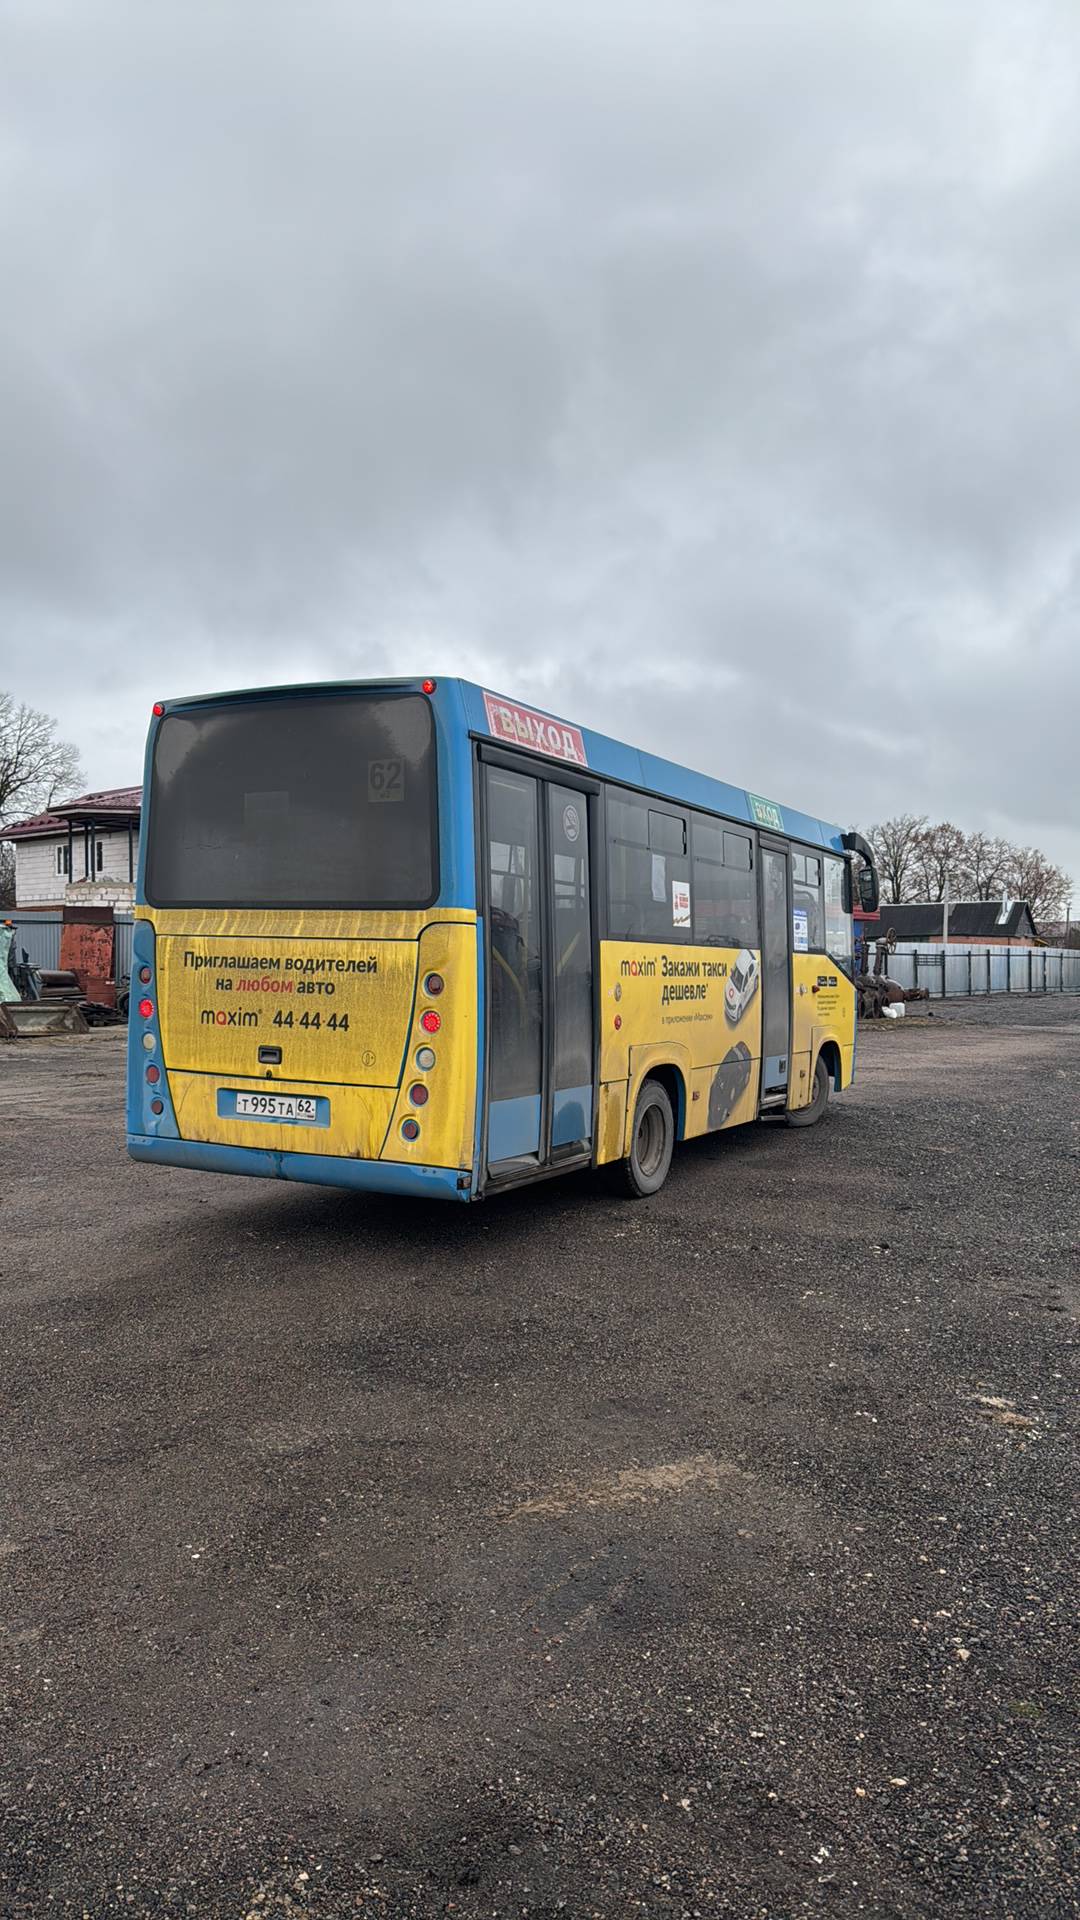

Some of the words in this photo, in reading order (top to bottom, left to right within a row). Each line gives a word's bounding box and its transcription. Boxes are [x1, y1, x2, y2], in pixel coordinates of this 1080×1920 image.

[496, 705, 578, 760] ВЫХОД
[370, 761, 401, 790] 62
[183, 951, 281, 971] Приглашаем
[285, 956, 378, 975] водителей
[621, 956, 656, 977] maxim
[661, 955, 700, 977] Закажи
[702, 961, 728, 977] такси
[215, 978, 232, 991] на
[236, 975, 293, 993] любом
[296, 981, 335, 995] авто
[201, 1007, 259, 1027] maxim
